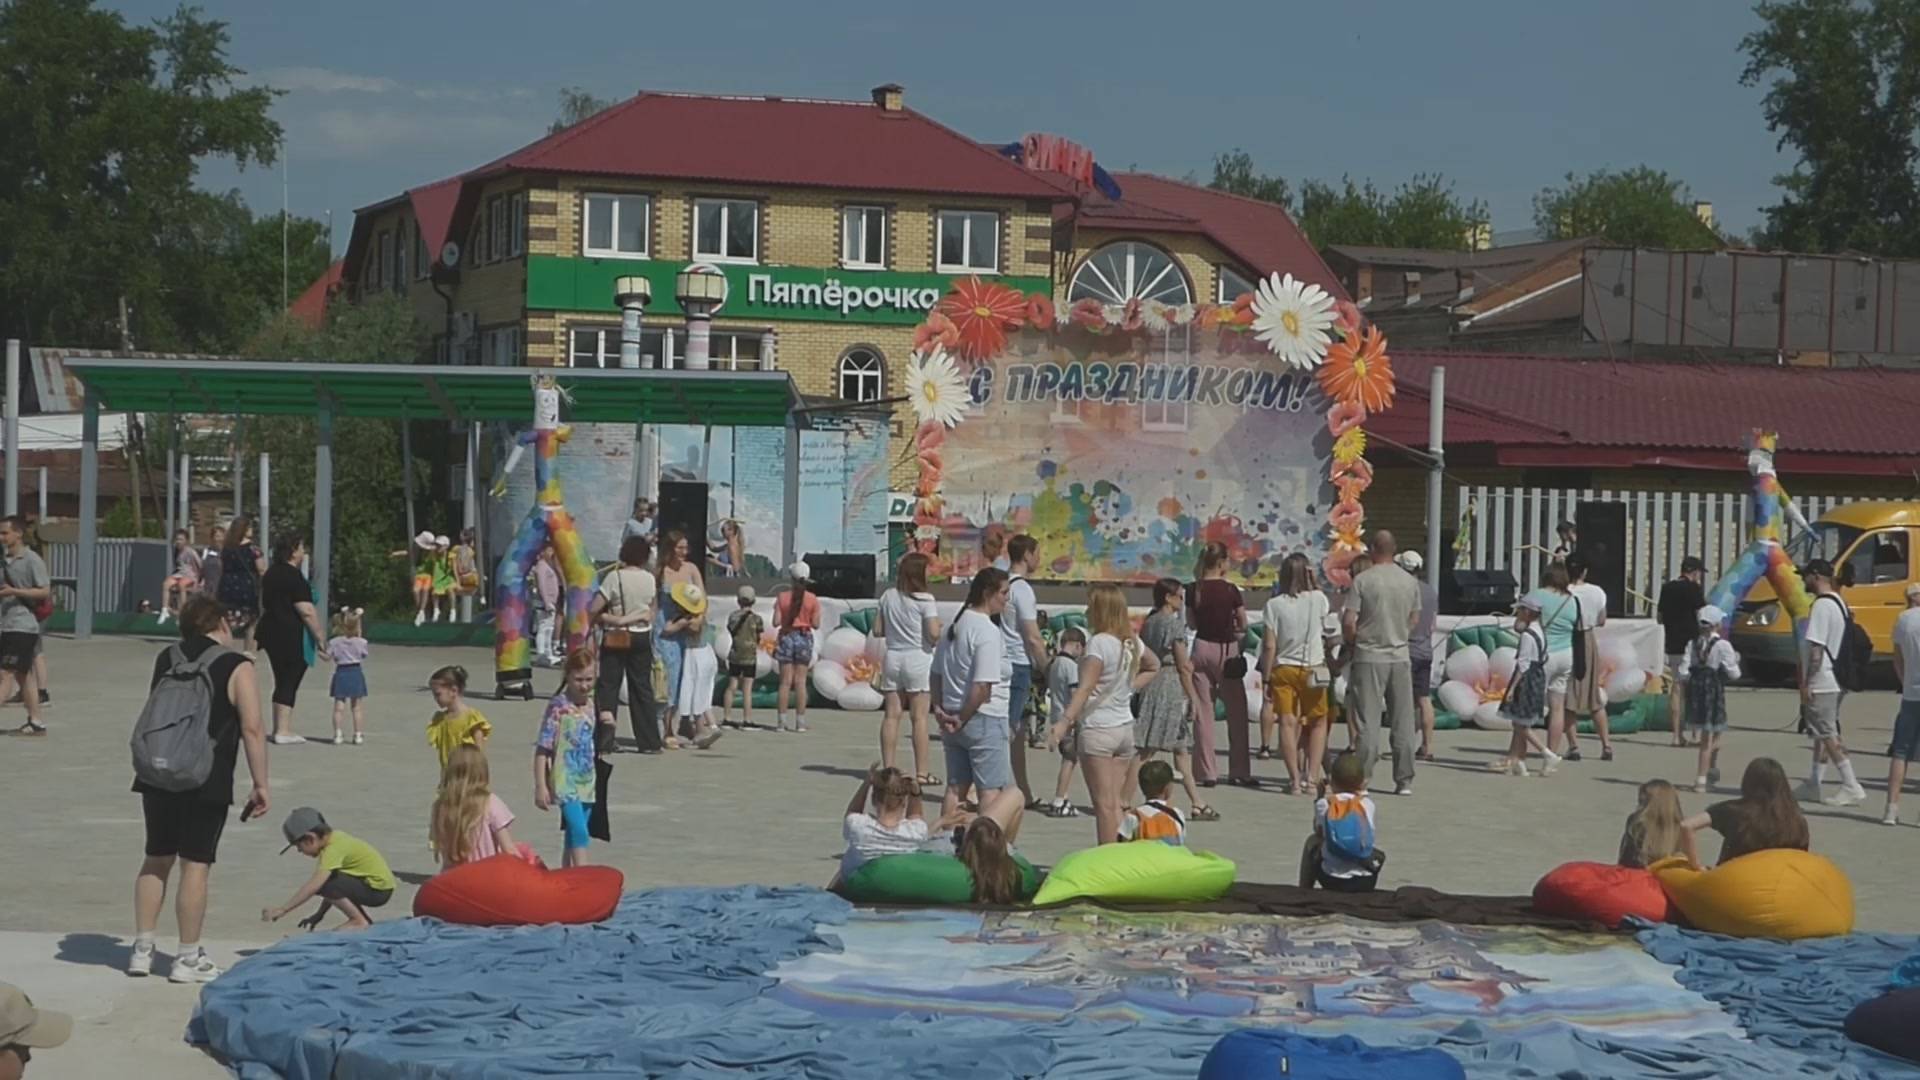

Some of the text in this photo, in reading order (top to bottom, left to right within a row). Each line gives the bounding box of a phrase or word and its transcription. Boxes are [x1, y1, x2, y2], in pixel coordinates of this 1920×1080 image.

[748, 273, 940, 314] Пятёрочка
[968, 361, 1312, 412] С ПРАЗДНИКОМ!
